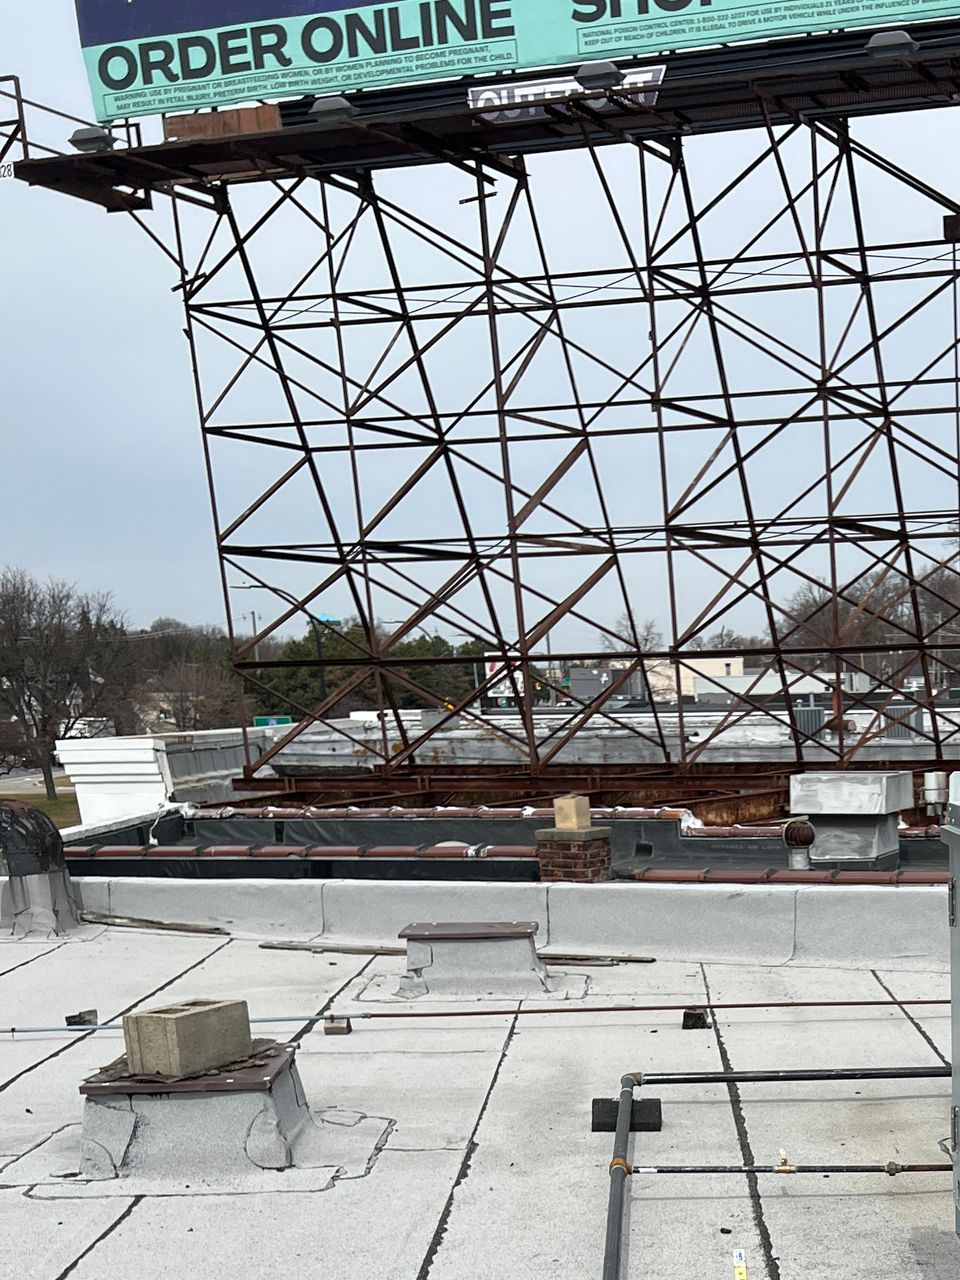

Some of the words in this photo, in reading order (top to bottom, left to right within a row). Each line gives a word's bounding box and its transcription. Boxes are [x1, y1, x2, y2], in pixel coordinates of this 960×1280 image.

[98, 24, 292, 91] ORDER
[301, 0, 515, 63] ONLINE
[582, 30, 612, 38] NATIONAL
[614, 26, 638, 34] POISON
[639, 22, 668, 31] CONTROL
[669, 18, 695, 27] CENTER:
[783, 2, 824, 12] INDIVIDUALS
[624, 33, 645, 41] REACH
[646, 31, 654, 39] OF
[702, 23, 727, 32] ILLEGAL
[737, 18, 756, 27] DRIVE
[762, 15, 787, 23] MOTOR
[837, 6, 860, 14] UNDER
[875, 0, 910, 9] INFLUENCE
[114, 91, 148, 102] WARNING:
[149, 89, 162, 97] USE
[173, 83, 210, 93] PREGNANT
[223, 73, 279, 87] BREASTFEEDING
[312, 68, 323, 76] OR
[335, 63, 364, 72] WOMEN
[365, 58, 403, 68] PLANNING
[415, 51, 447, 60] BECOME
[448, 45, 491, 56] PREGNANT,
[116, 103, 131, 111] MAY
[132, 100, 156, 108] RESULT
[213, 88, 246, 98] PRETERM
[270, 81, 286, 89] LOW
[288, 79, 309, 88] BIRTH
[353, 65, 414, 80] DEVELOPMENTAL
[415, 60, 456, 70] PROBLEMS
[489, 52, 514, 61] CHILD.
